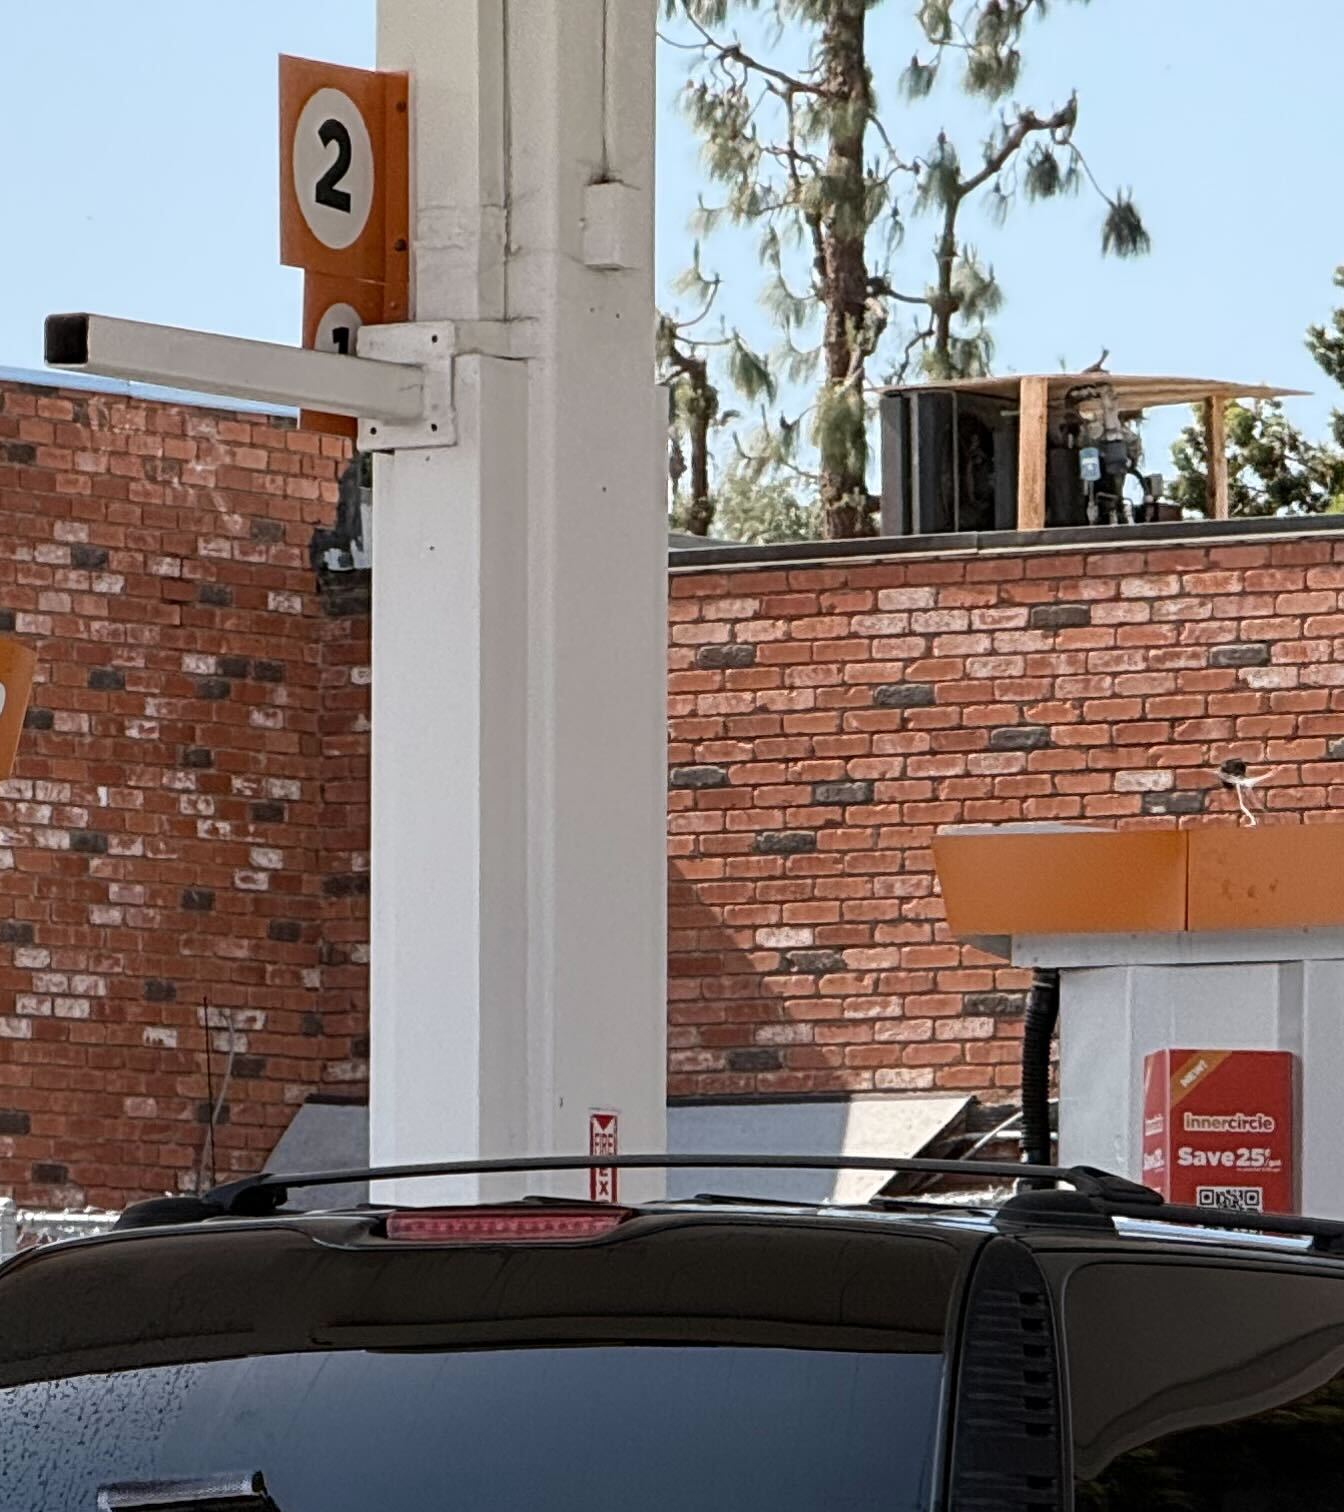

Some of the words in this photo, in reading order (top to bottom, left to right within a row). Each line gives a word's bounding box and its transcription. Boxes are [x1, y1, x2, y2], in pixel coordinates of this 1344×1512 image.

[315, 119, 352, 214] 2
[1185, 1113, 1274, 1131] innercircle
[1177, 1147, 1234, 1167] Save
